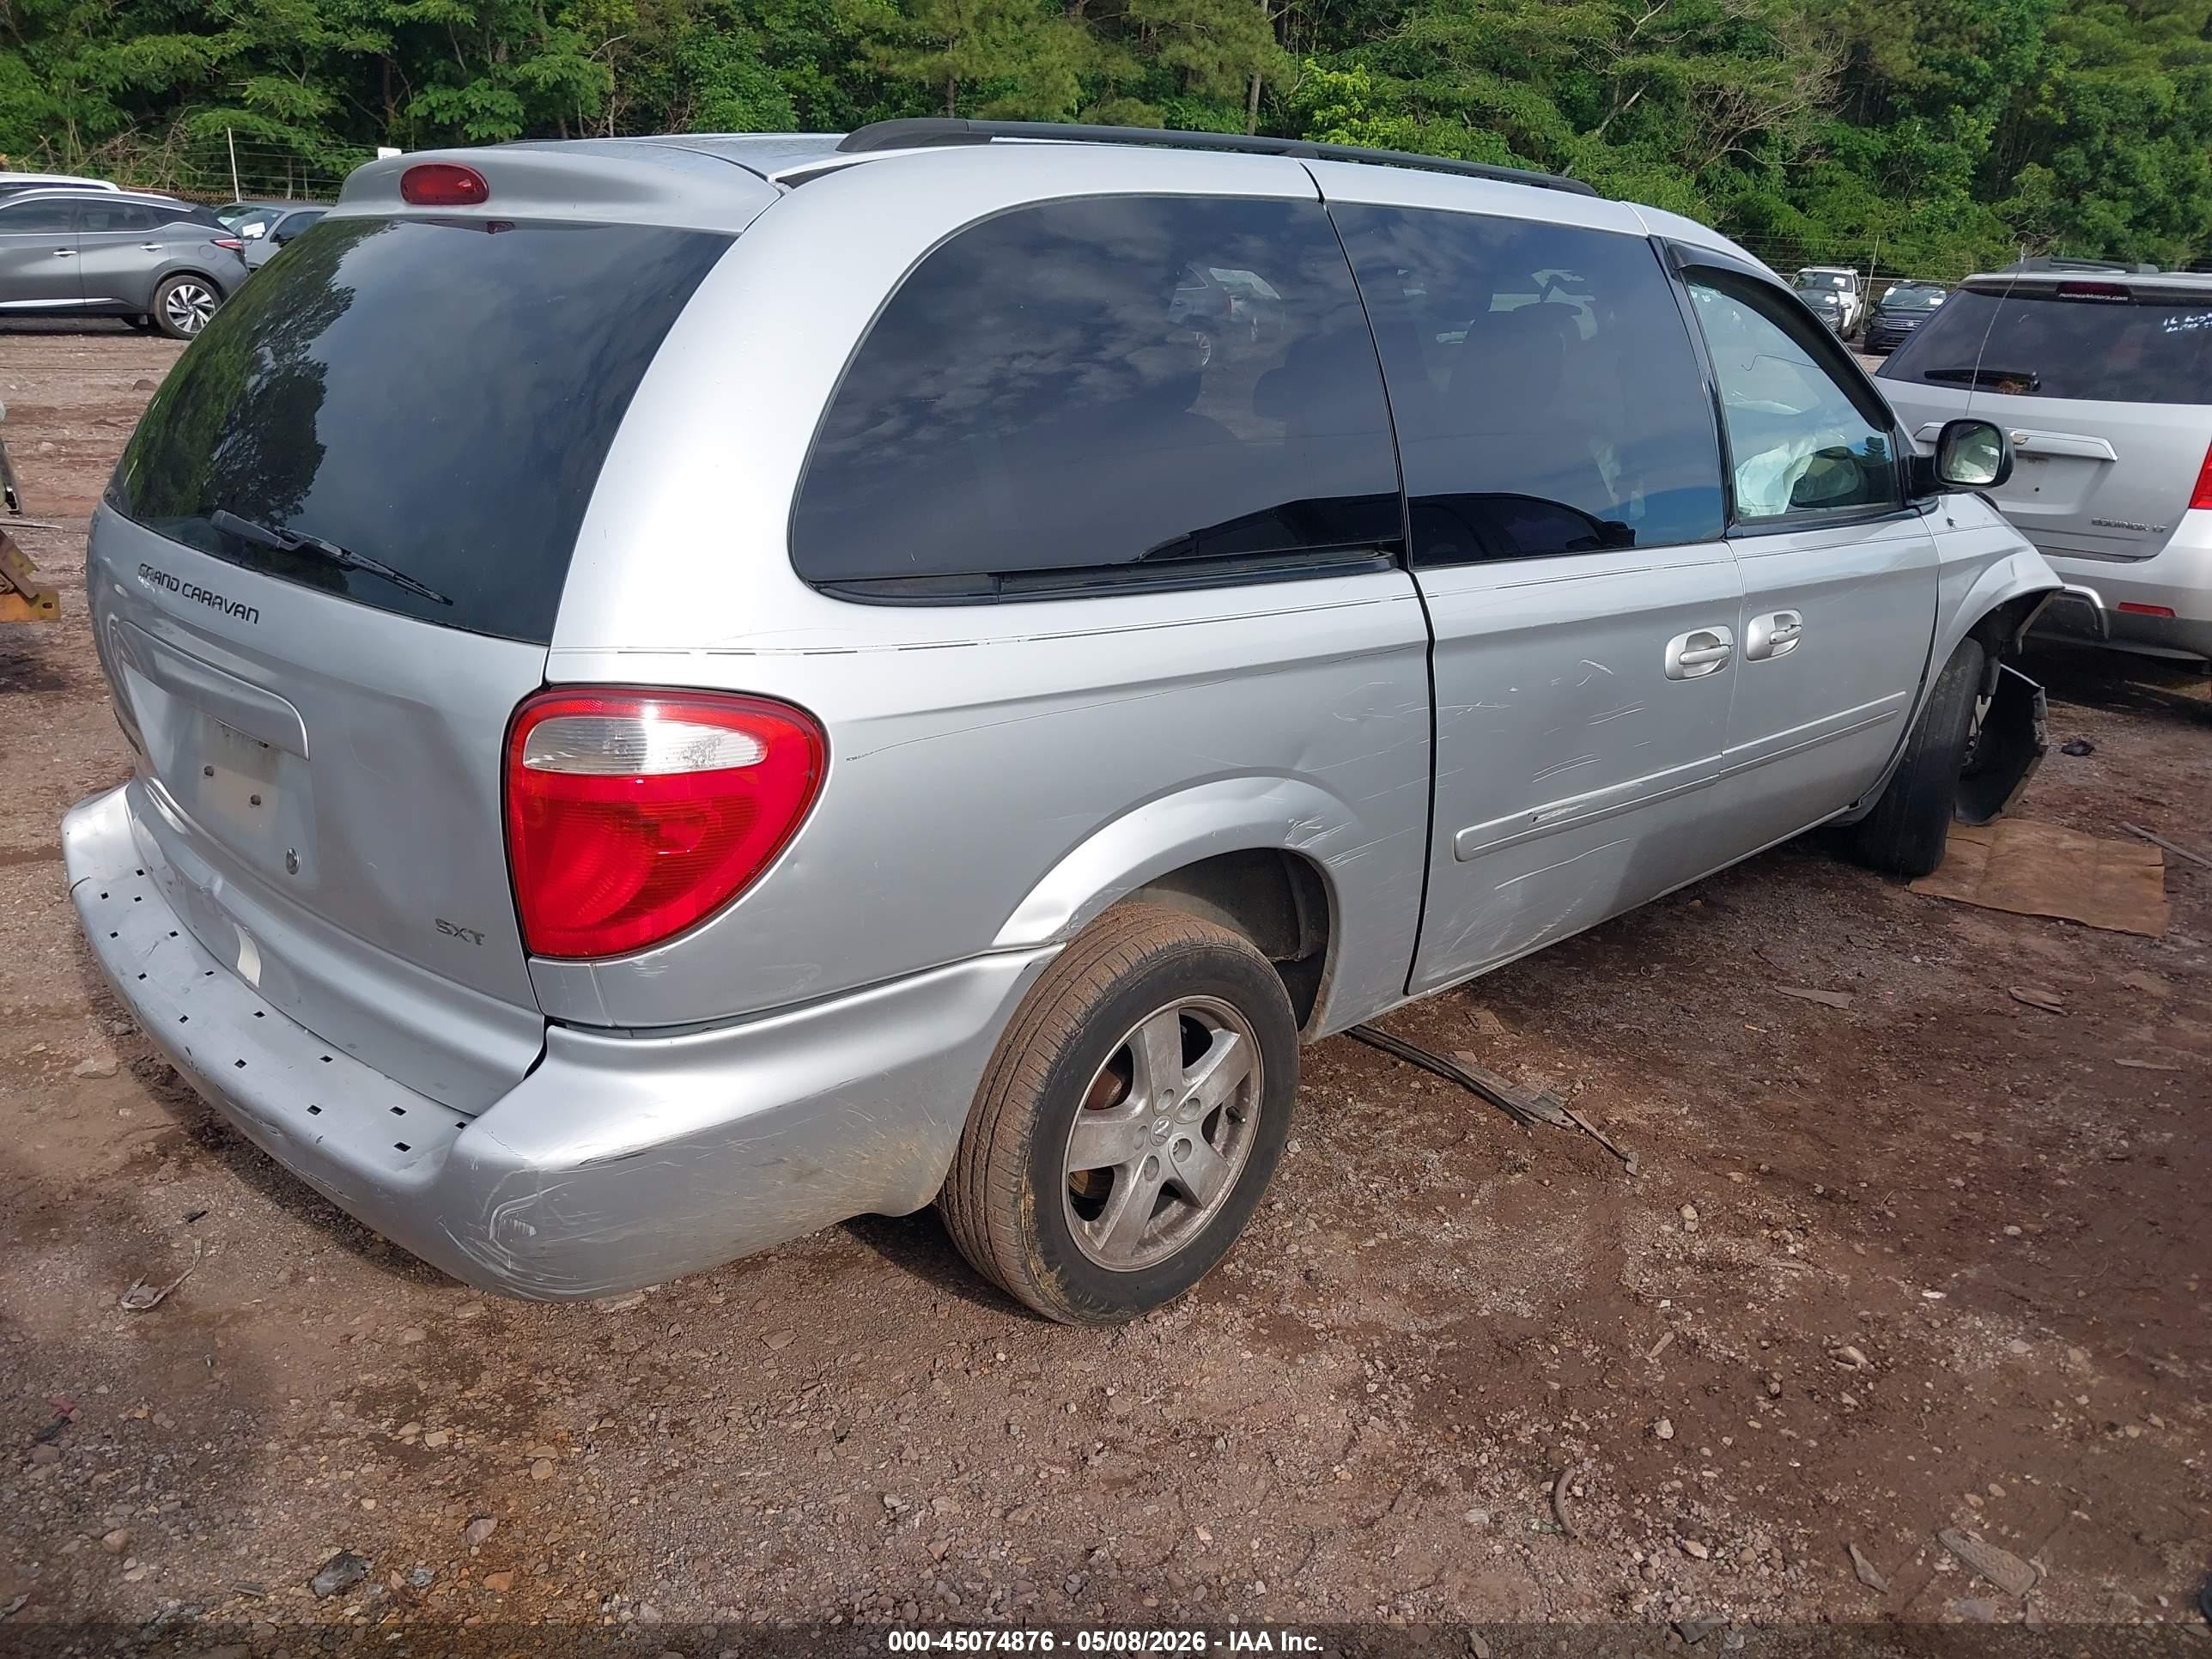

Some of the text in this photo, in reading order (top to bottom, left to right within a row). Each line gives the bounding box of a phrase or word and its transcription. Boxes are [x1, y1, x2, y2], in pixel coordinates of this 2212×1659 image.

[137, 562, 259, 624] GRAND CARAVAN
[434, 918, 485, 945] SXT
